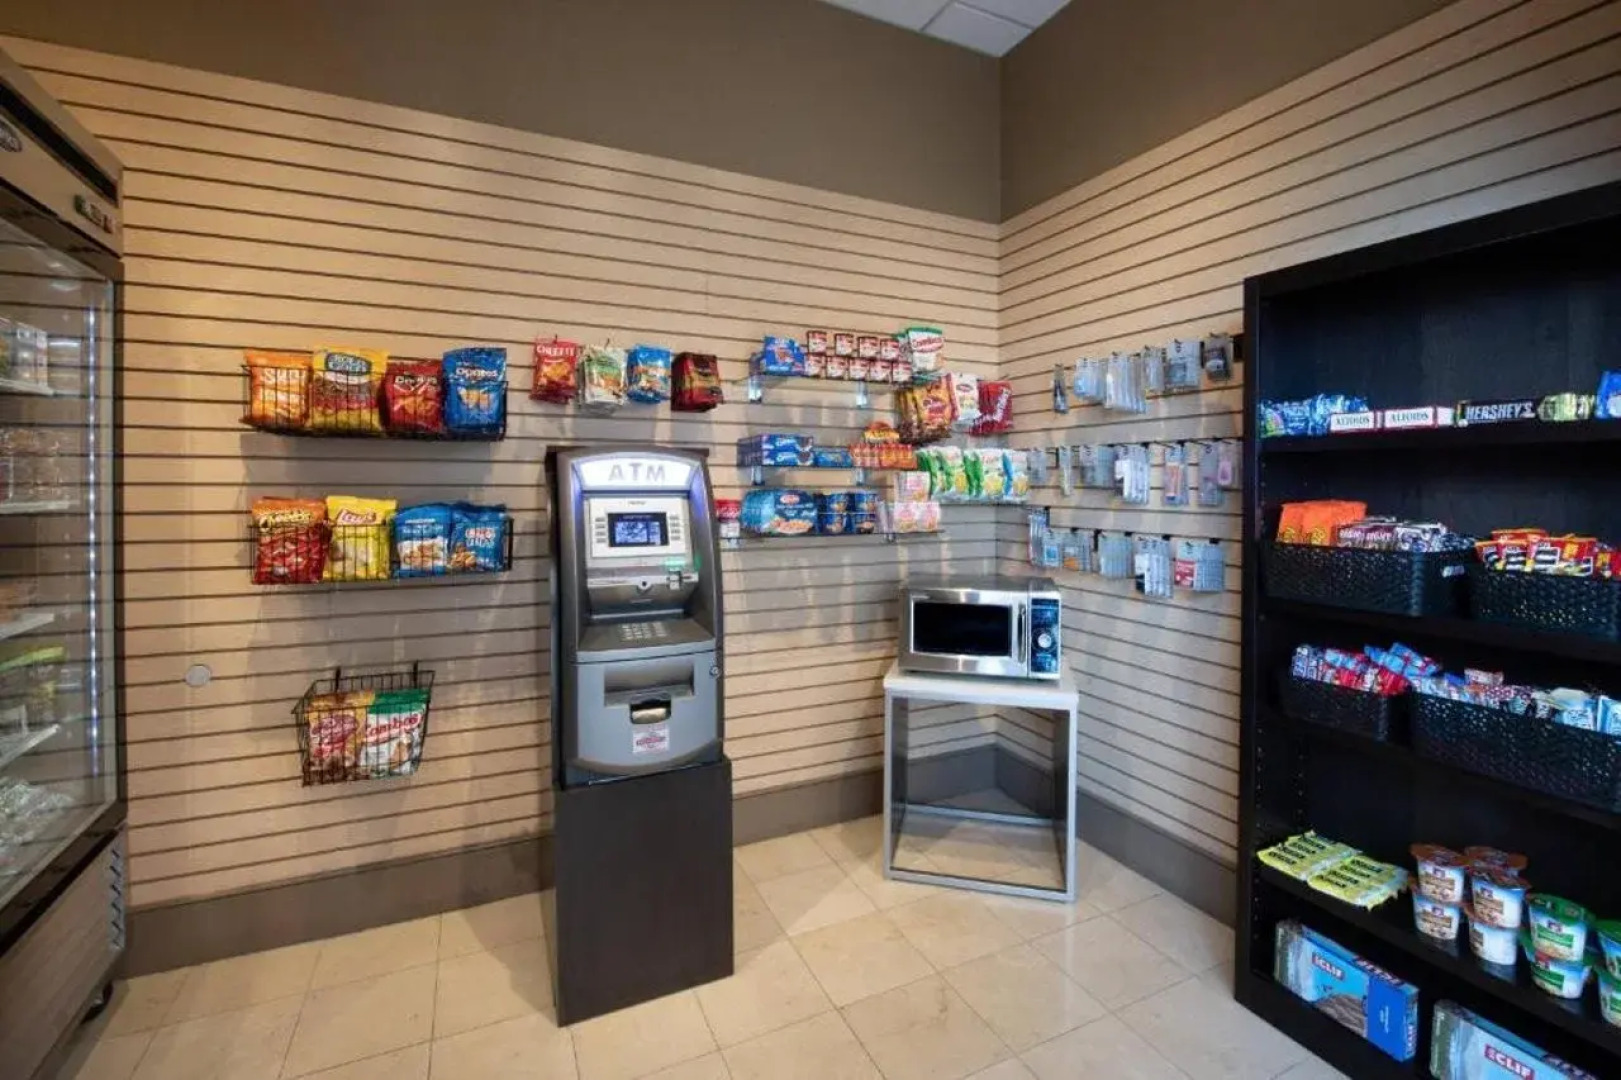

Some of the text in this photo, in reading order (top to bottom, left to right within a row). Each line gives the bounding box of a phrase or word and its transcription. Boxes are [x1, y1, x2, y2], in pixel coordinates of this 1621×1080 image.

[1466, 401, 1536, 421] HERSHEY'S
[608, 462, 666, 482] ATM
[1320, 957, 1344, 980] CLIF
[1495, 1050, 1532, 1080] CLIF
